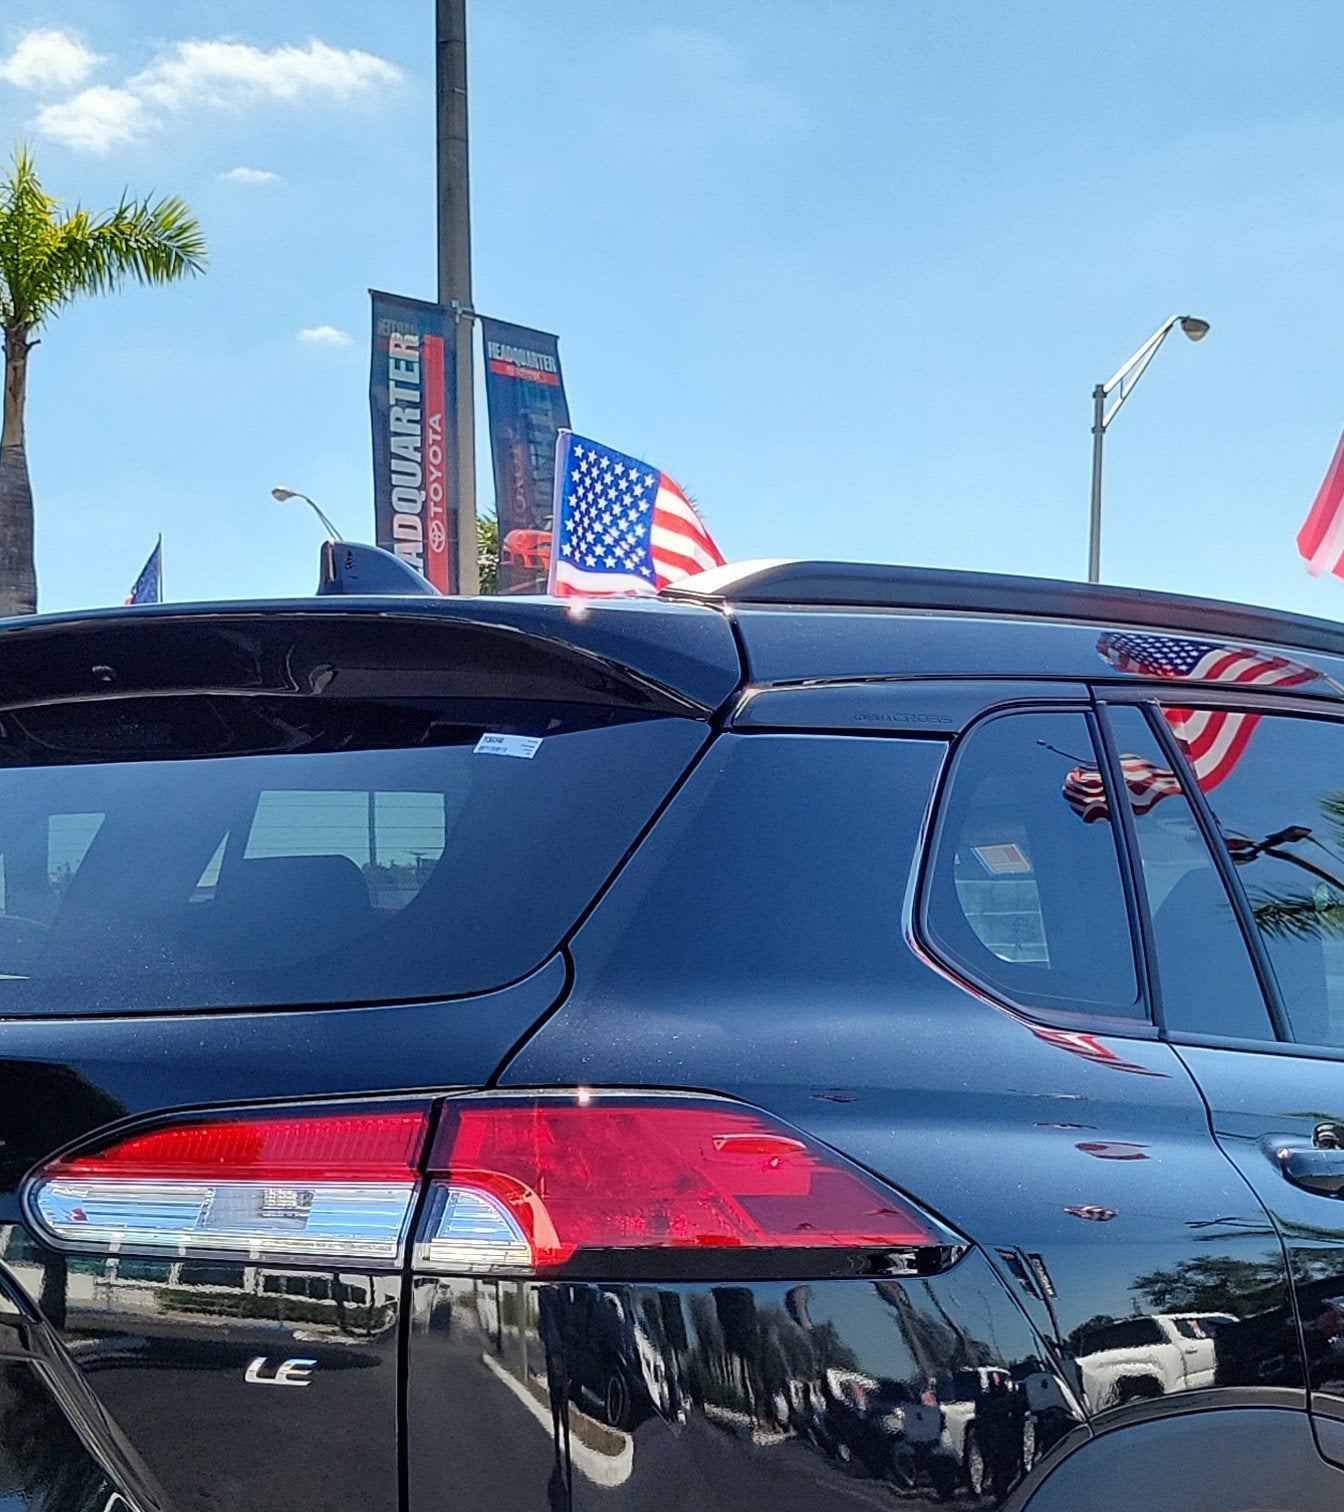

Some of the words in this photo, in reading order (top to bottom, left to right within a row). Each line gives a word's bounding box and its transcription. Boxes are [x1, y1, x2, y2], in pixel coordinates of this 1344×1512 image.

[389, 332, 424, 577] ADQUARTER
[428, 413, 444, 517] TOYOTA
[244, 1356, 317, 1386] LE
